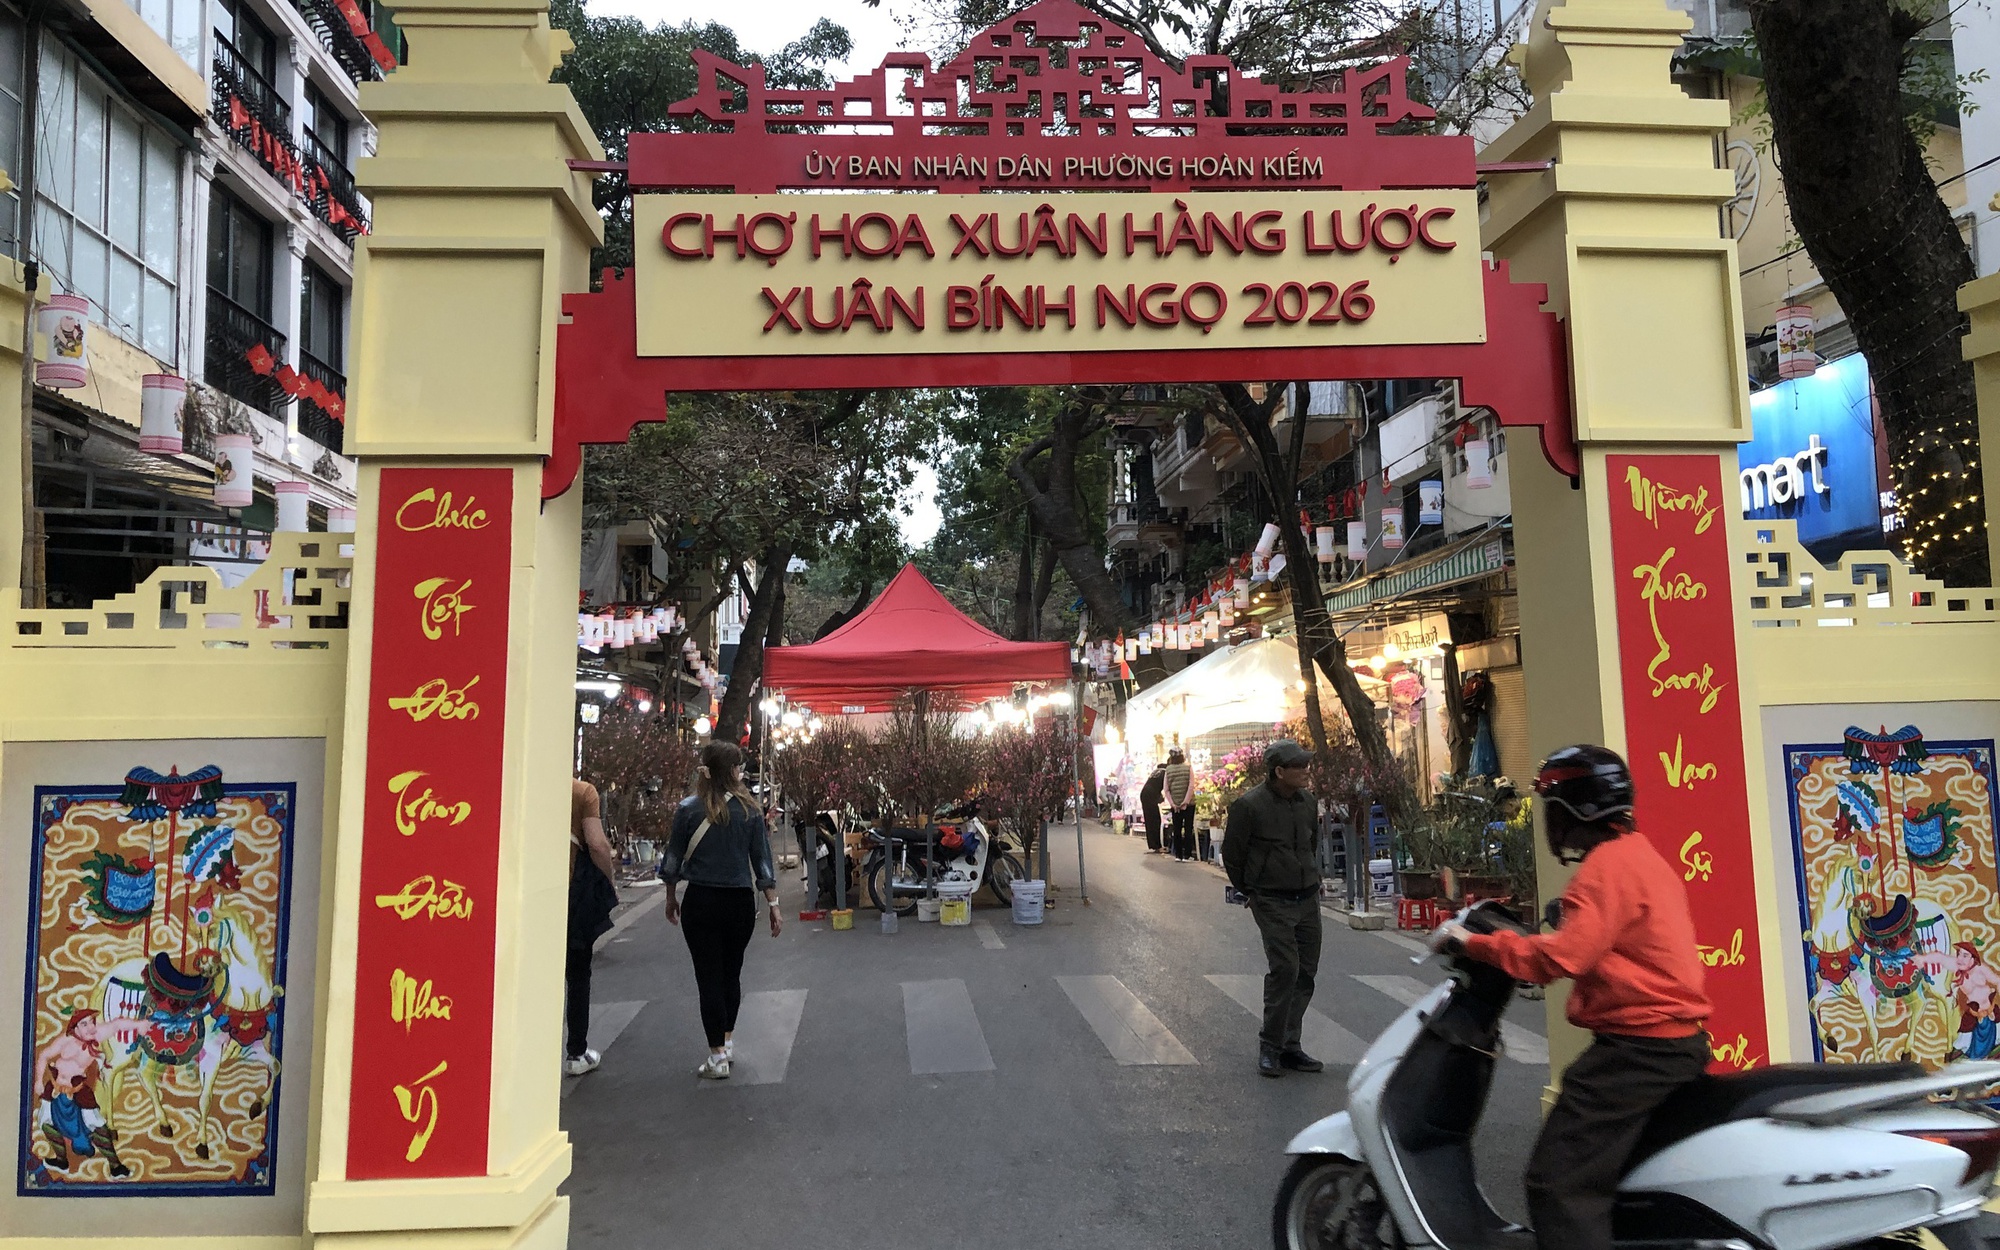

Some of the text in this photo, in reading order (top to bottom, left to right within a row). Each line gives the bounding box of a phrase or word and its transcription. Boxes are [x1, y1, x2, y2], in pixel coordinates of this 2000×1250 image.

[805, 147, 1325, 178] ỦY BAN NHÂN DÂN PHƯỜNG HOÀN KIẾM
[661, 198, 1458, 267] CHỢ HOA XUÂN HÀNG LƯỢC
[761, 274, 1376, 335] XUÂN BÍNH NGỌ 2026
[396, 488, 491, 531] Chúc
[1625, 465, 1723, 535] Mừng
[413, 576, 477, 640] Tết
[388, 674, 480, 722] Đến
[1648, 644, 1729, 714] Sang
[1659, 733, 1717, 791] Vạn
[387, 770, 472, 836] Trăm
[1680, 831, 1713, 882] Sự
[375, 875, 474, 920] Điều
[389, 968, 453, 1036] Như
